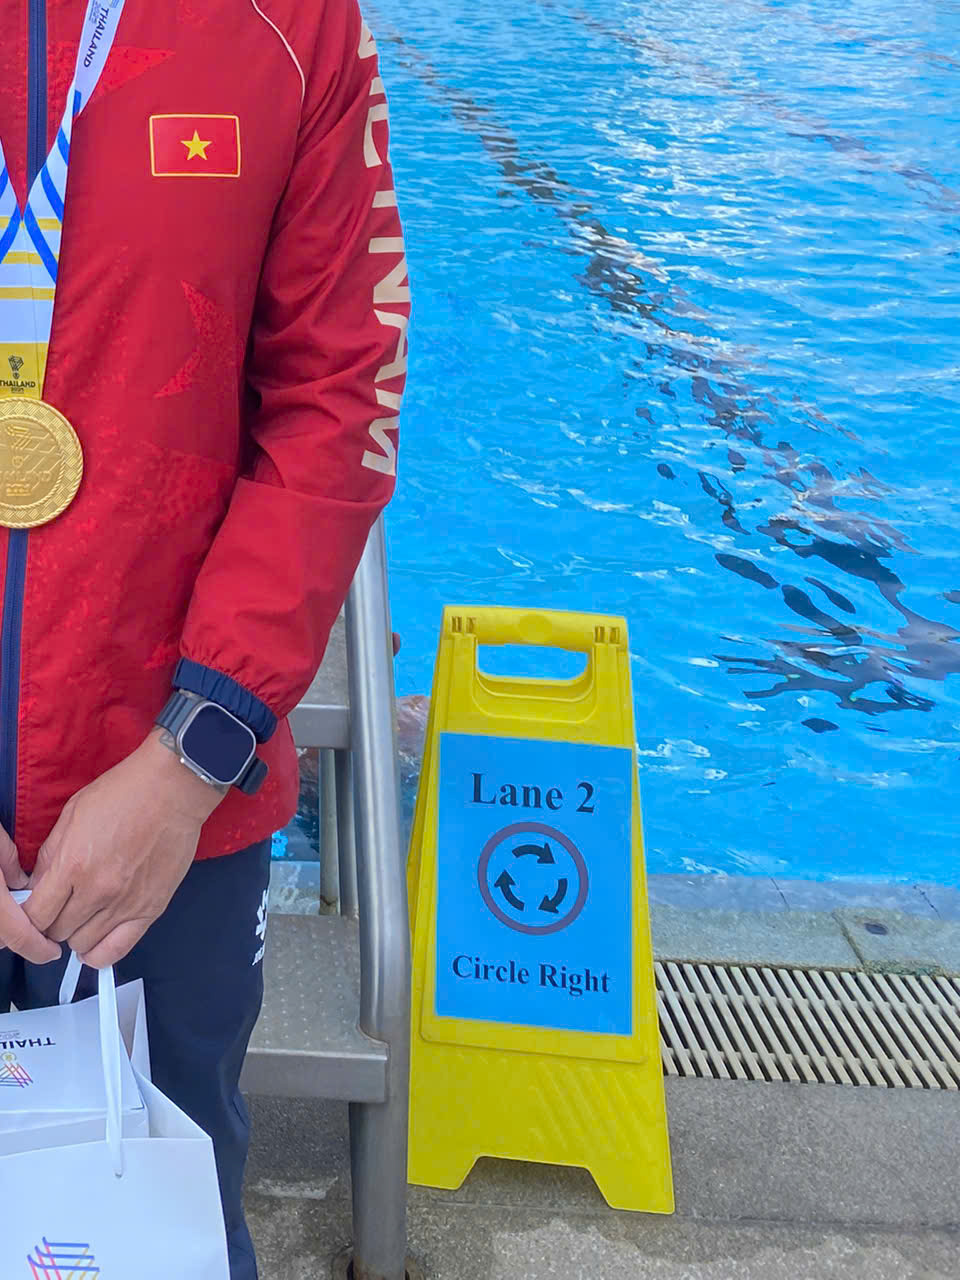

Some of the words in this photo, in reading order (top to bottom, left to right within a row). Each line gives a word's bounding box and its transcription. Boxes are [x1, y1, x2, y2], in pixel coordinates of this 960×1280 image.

[84, 7, 109, 67] THAILAND
[471, 772, 563, 810] Lane
[576, 781, 595, 813] 2
[452, 955, 530, 984] Circle
[538, 963, 610, 996] Right
